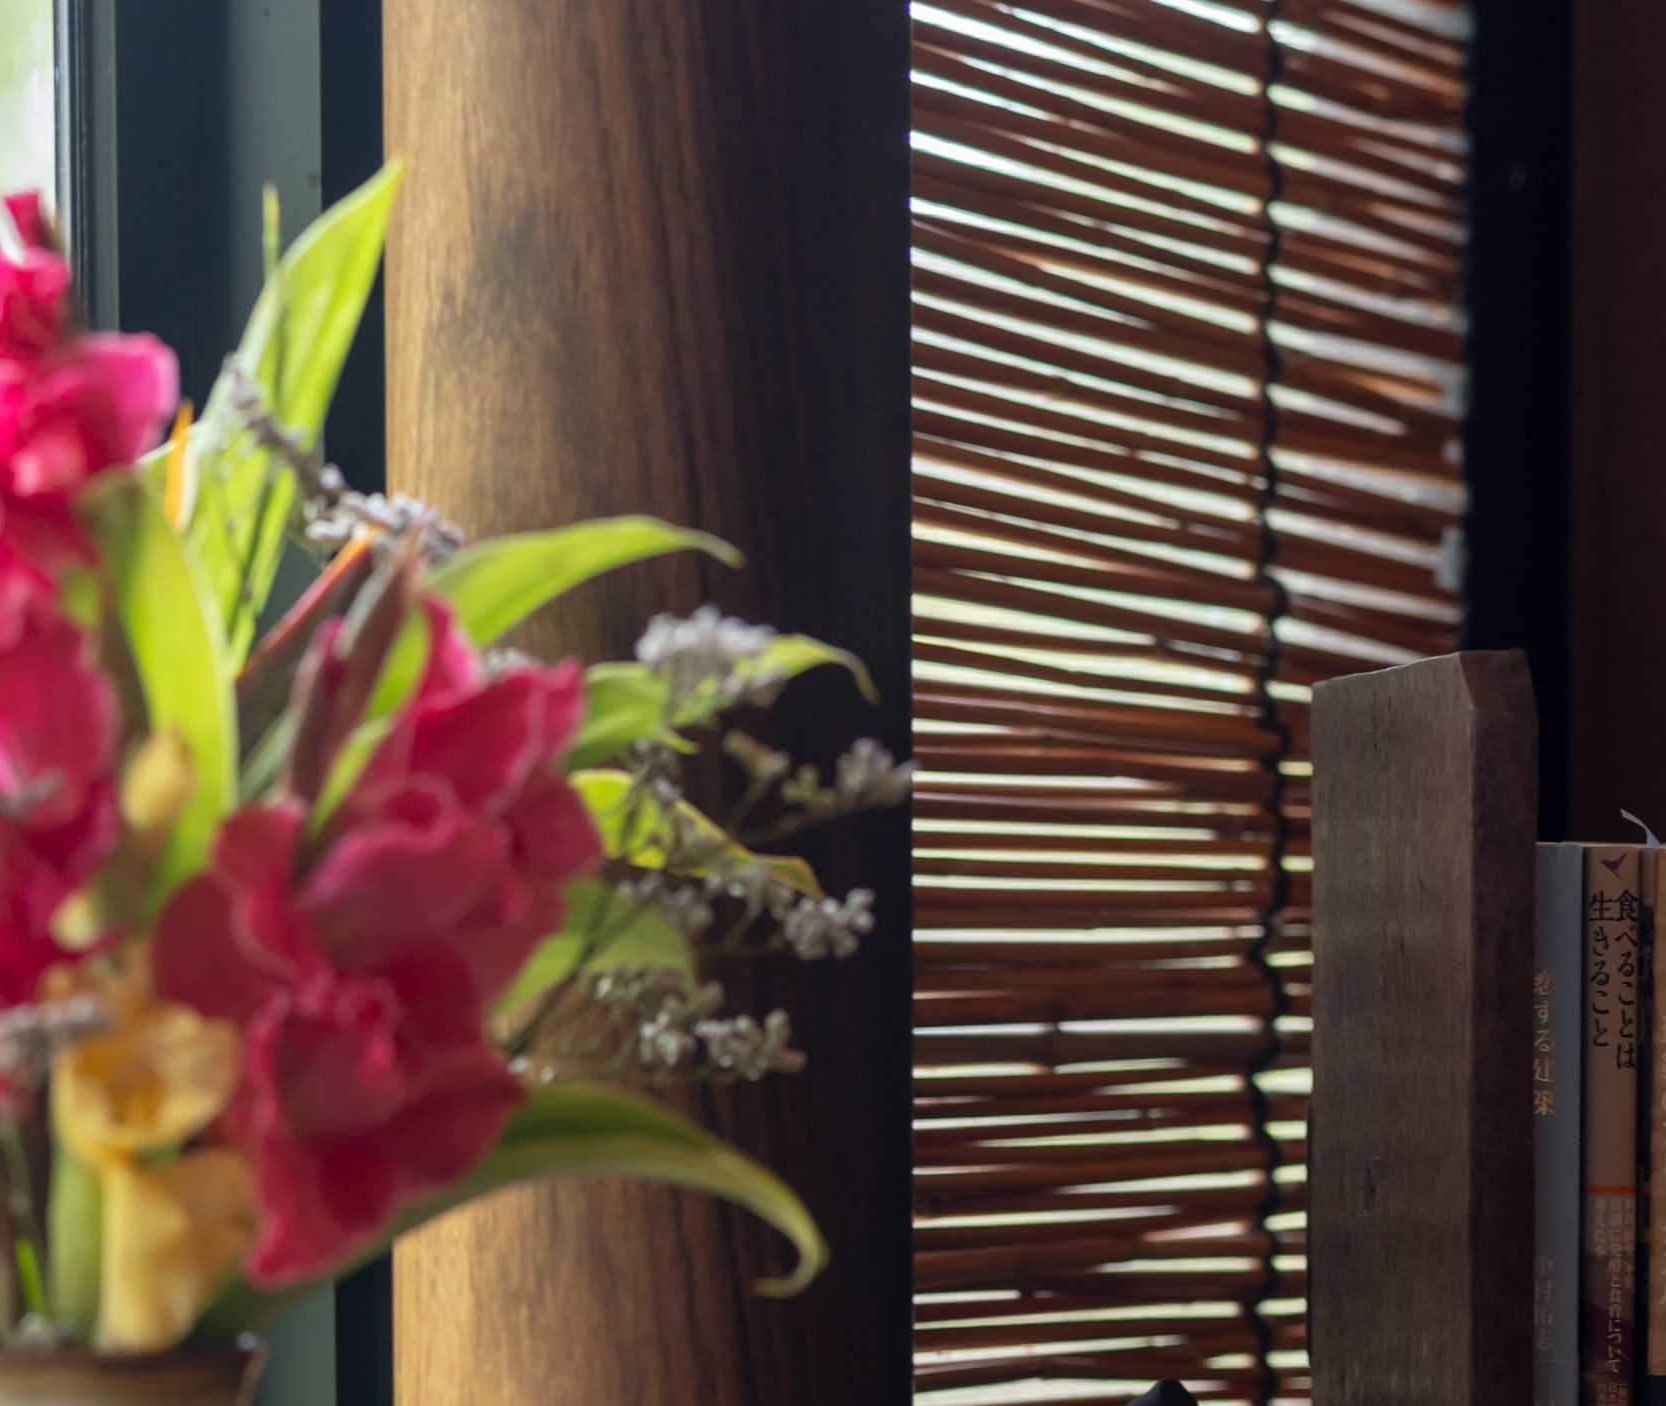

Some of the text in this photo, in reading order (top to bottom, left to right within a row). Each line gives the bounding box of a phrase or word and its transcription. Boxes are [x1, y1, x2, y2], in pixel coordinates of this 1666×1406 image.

[1589, 890, 1615, 1047] 生きること
[1615, 890, 1638, 1069] 食べることは
